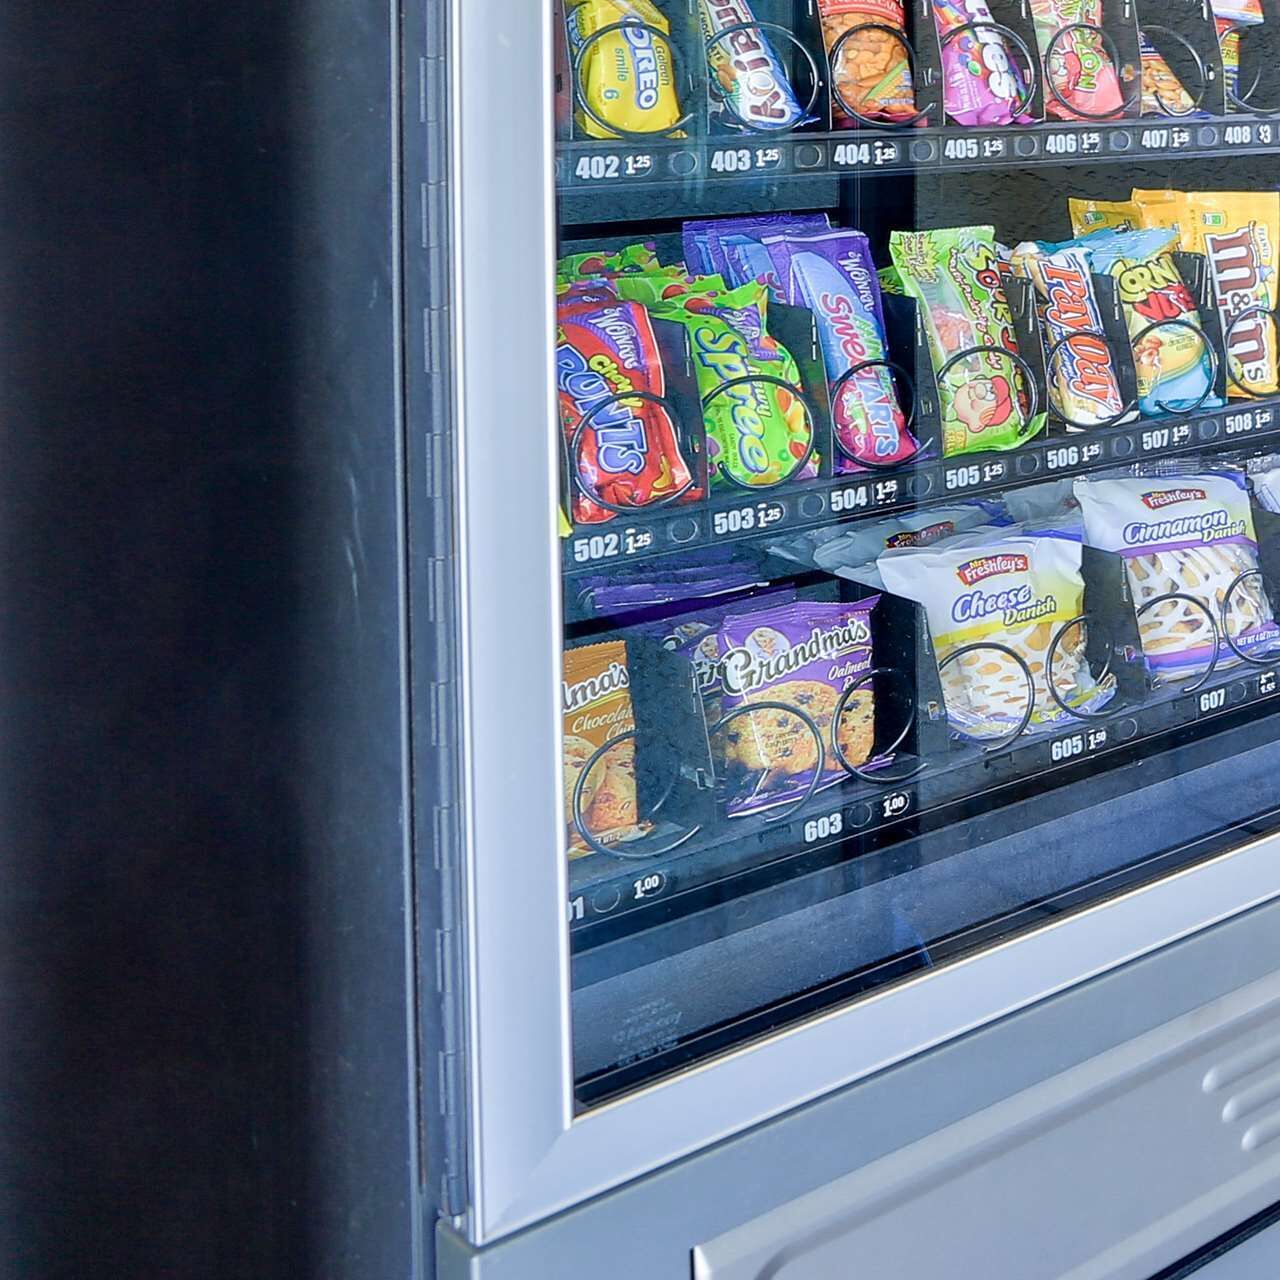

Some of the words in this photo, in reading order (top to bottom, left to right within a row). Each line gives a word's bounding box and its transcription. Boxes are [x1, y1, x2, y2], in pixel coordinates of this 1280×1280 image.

[620, 17, 658, 110] OREO
[656, 44, 672, 88] Golden
[1046, 133, 1076, 153] 406
[1141, 129, 1169, 148] 407
[1172, 131, 1190, 147] 1.25
[1225, 125, 1251, 144] 408
[1259, 126, 1271, 144] $3
[711, 148, 751, 172] 403
[756, 149, 780, 169] 1.25
[834, 144, 870, 165] 404
[874, 146, 896, 165] 1.25
[945, 139, 979, 159] 405
[983, 140, 1003, 158] 1.25
[576, 156, 619, 180] 402
[625, 155, 651, 175] 1.25
[967, 241, 1013, 323] SOUR
[1109, 253, 1180, 303] CORN
[1225, 413, 1251, 434] 508
[1254, 412, 1271, 430] 1.25
[1142, 430, 1170, 450] 507
[1172, 426, 1190, 442] 1.25
[1047, 447, 1078, 468] 506
[1081, 443, 1100, 462] 1.25
[946, 469, 980, 490] 505
[983, 464, 1003, 482] 1.25
[830, 490, 868, 512] 504
[875, 481, 897, 500] 1.25
[713, 511, 753, 535] 503
[757, 505, 782, 527] 1.25
[1123, 509, 1228, 545] Cinnamon
[1201, 521, 1246, 543] Danish
[574, 535, 618, 561] 502
[625, 532, 652, 554] 1.25
[964, 557, 1026, 581] Freshley's
[952, 584, 1032, 624] Cheese
[1002, 594, 1057, 626] Danish
[720, 622, 870, 697] Grandma's
[1199, 689, 1225, 711] 607
[1051, 735, 1084, 760] 605
[804, 814, 842, 842] 603
